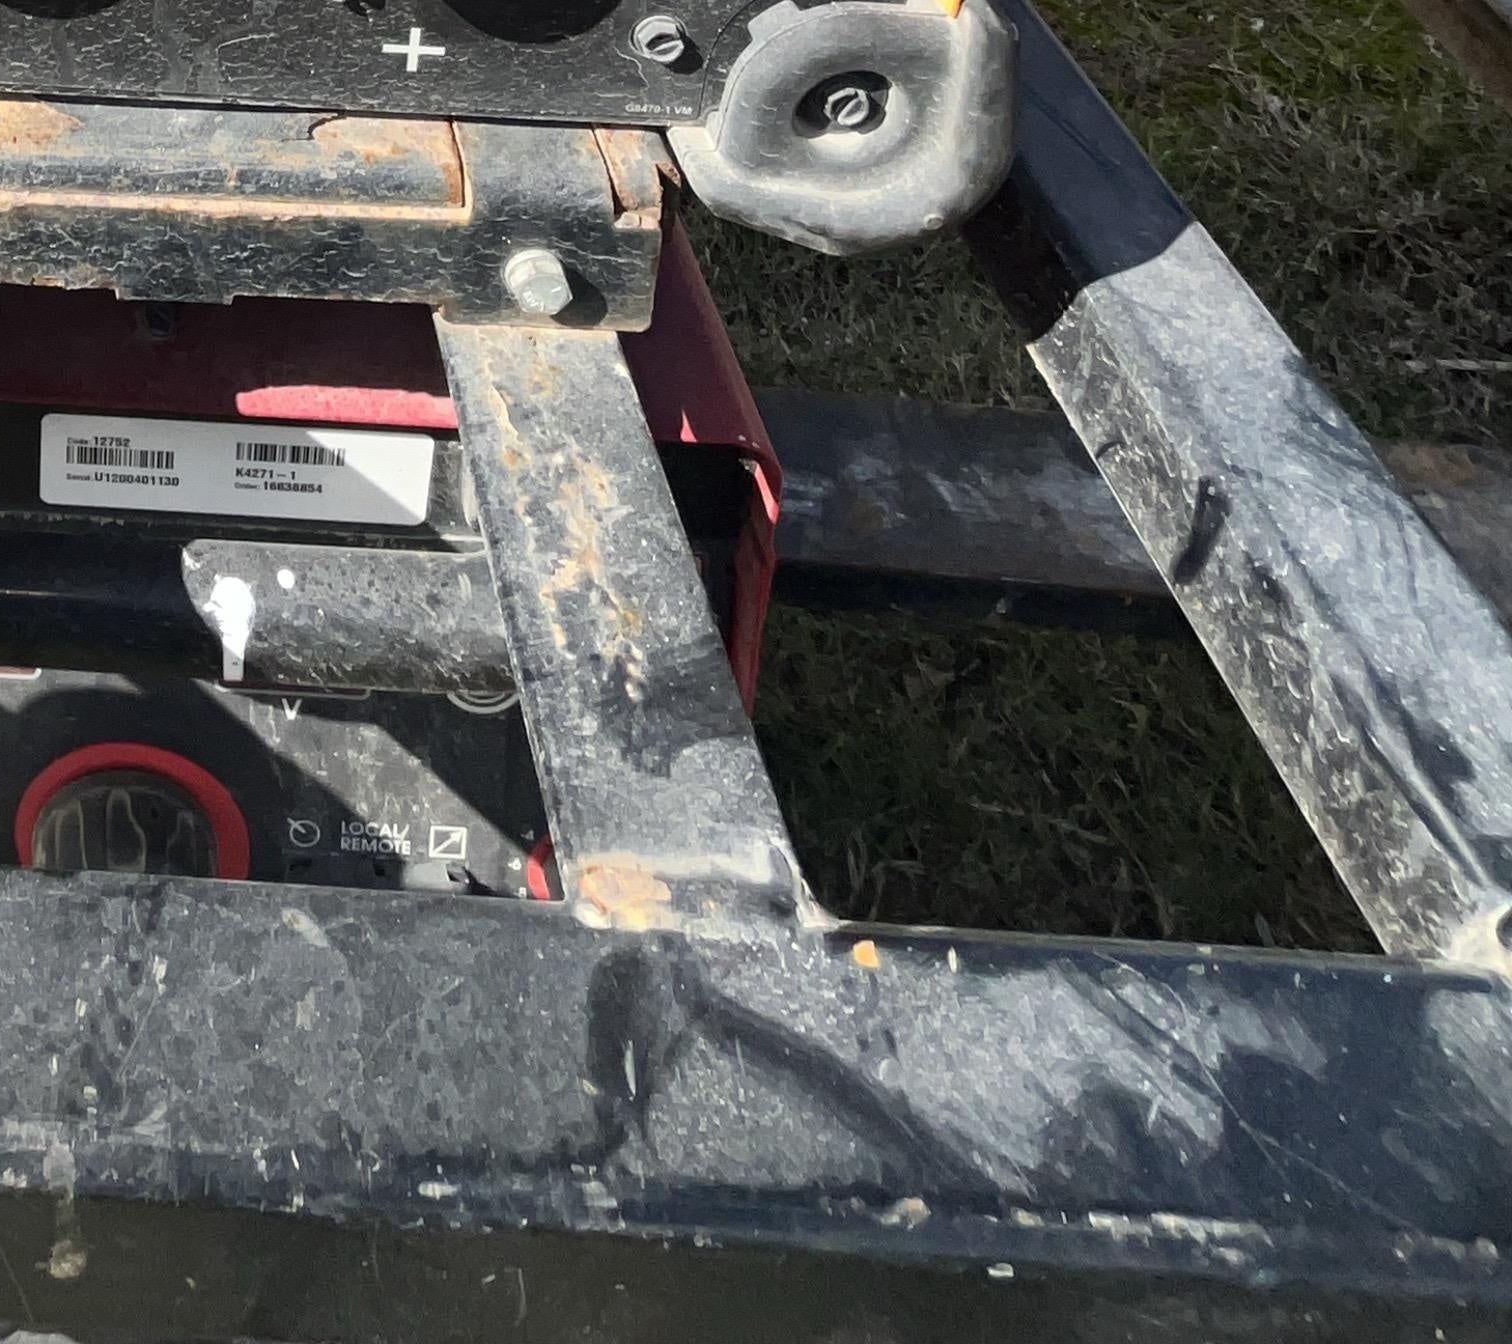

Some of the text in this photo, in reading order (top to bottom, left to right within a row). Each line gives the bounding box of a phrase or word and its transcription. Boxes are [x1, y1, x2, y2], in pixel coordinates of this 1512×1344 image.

[93, 436, 131, 448] 12752
[281, 697, 303, 720] V
[340, 820, 410, 841] LOCAL/
[340, 837, 412, 856] REMOTE
